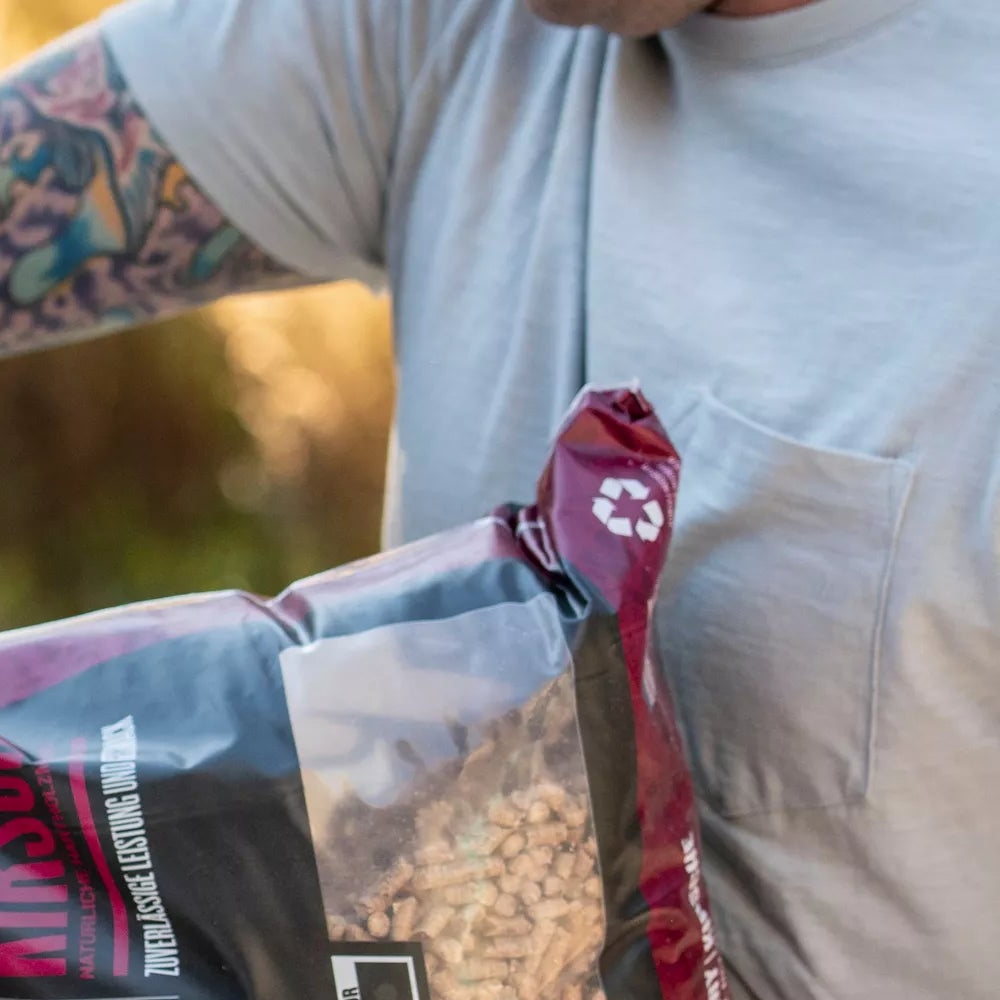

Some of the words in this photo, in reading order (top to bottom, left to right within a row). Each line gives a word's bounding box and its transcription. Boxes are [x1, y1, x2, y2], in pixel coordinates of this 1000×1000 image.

[100, 761, 138, 795] UND
[104, 793, 153, 871] LEISTUNG
[123, 871, 180, 977] ZUVERLÄSSIGE
